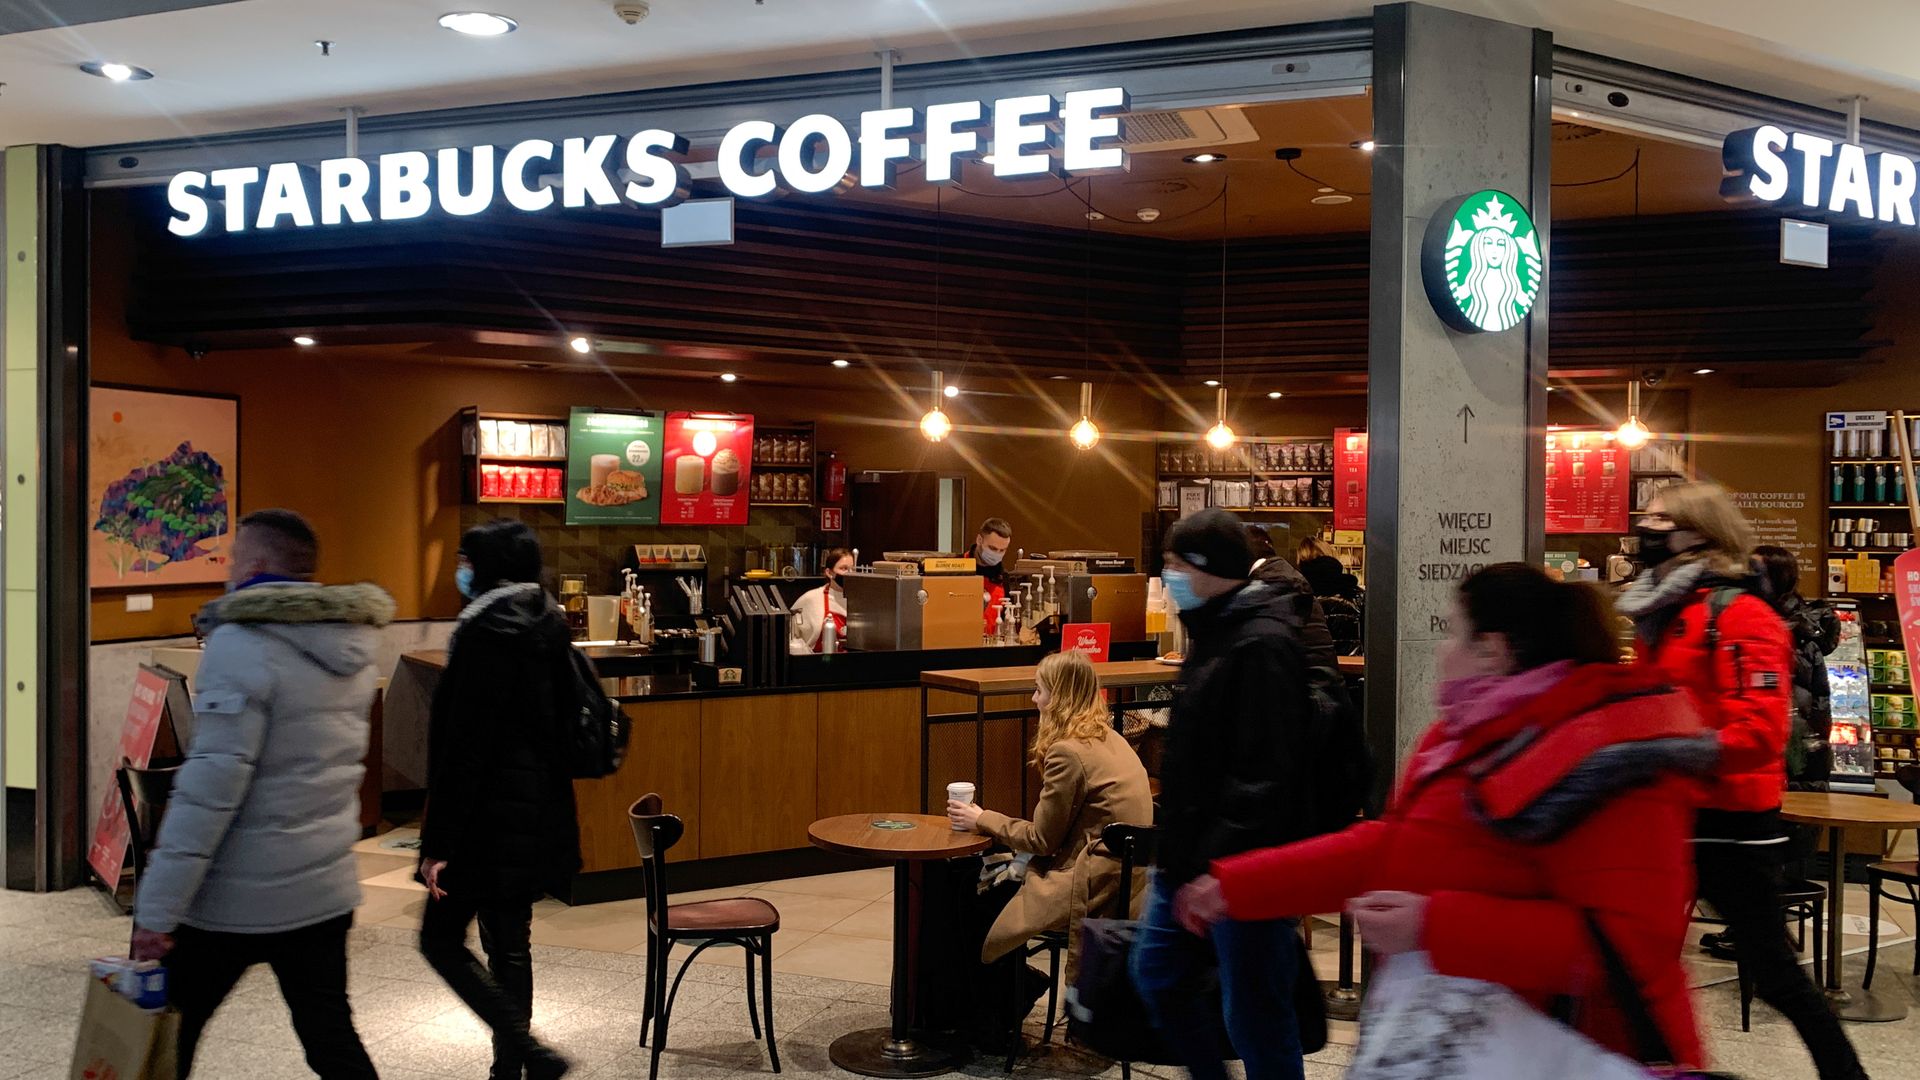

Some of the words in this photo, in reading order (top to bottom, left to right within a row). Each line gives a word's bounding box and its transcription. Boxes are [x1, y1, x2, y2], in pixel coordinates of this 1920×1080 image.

[168, 129, 678, 236] STARBUCKS
[717, 87, 1125, 197] COFFEE
[1739, 492, 1759, 500] OUR
[1759, 492, 1795, 500] COFFEE
[1797, 492, 1806, 500] IS
[1761, 501, 1804, 509] SOURCED
[1438, 512, 1492, 532] WIĘCEJ
[1440, 538, 1491, 555] MIEJSC
